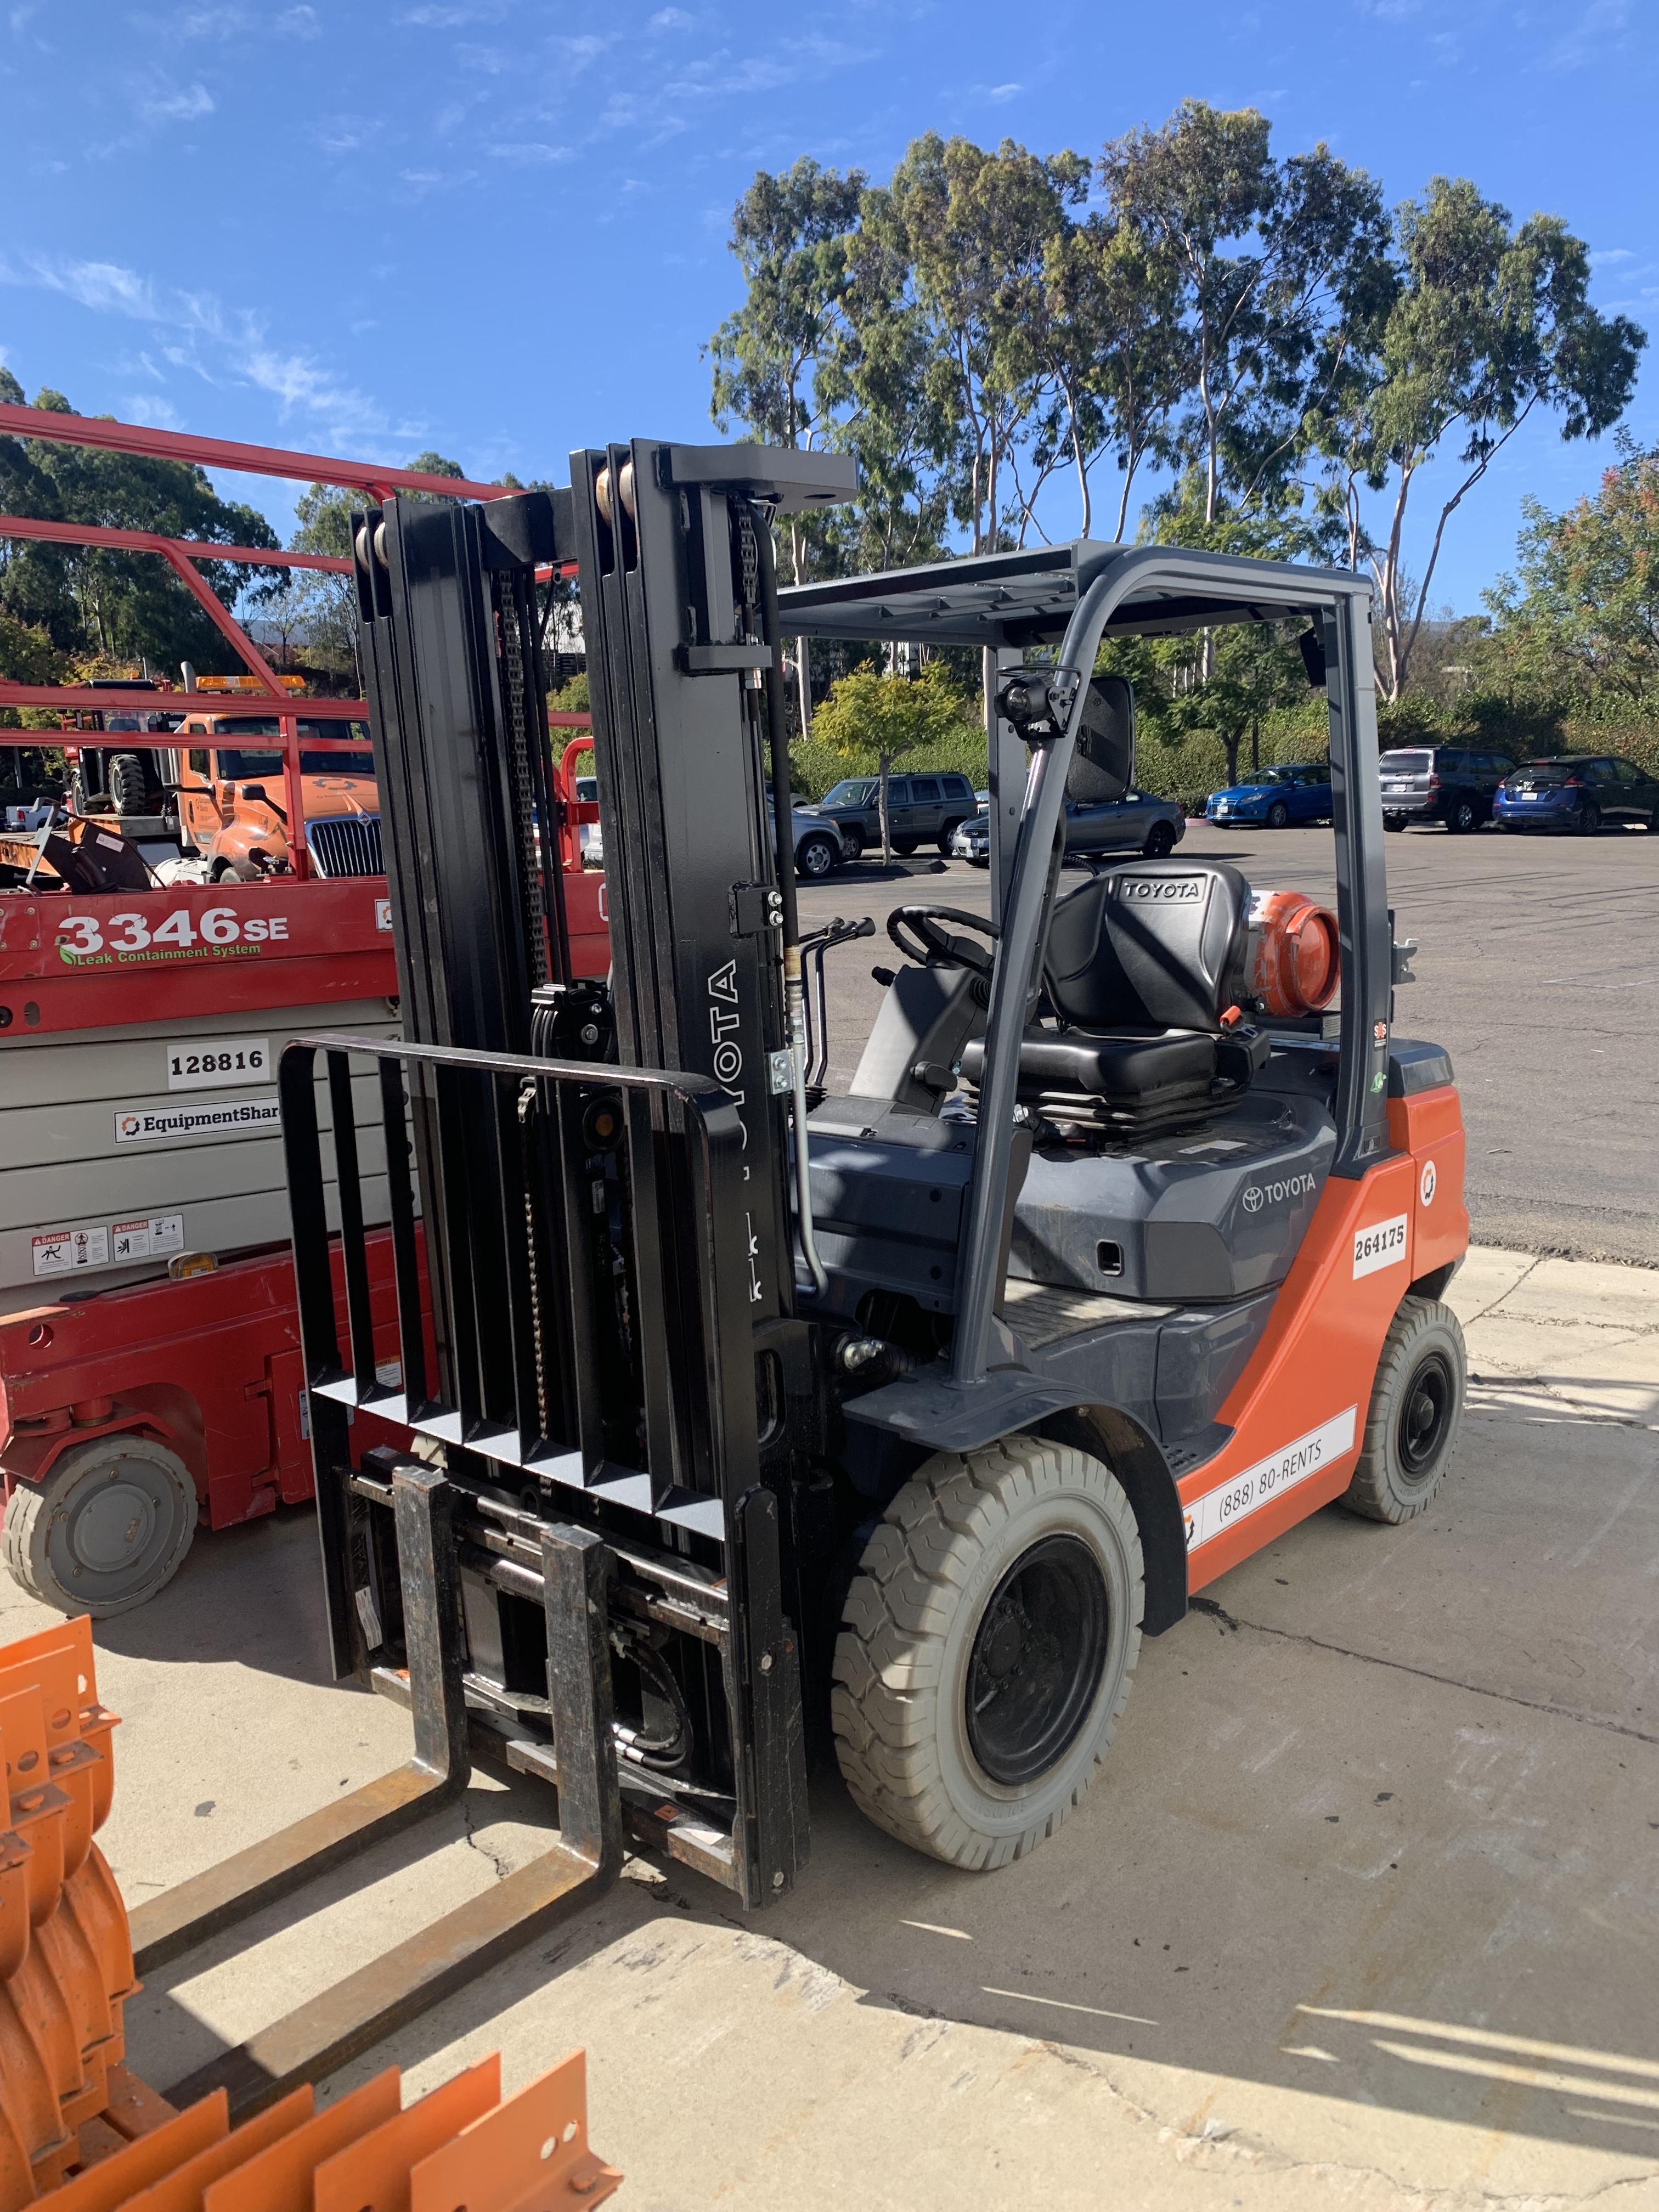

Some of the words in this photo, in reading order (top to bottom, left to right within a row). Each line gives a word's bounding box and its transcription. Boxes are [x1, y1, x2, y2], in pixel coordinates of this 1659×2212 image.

[1125, 882, 1198, 898] TOYOTA
[76, 954, 113, 966] Leak
[117, 947, 208, 963] Containment
[212, 944, 261, 957] System
[171, 1051, 263, 1076] 128816
[708, 959, 749, 1181] OTA
[143, 1106, 280, 1132] EquipmentShar
[1265, 1172, 1316, 1204] TOYOTA
[42, 1234, 70, 1244] DANGER
[121, 1222, 148, 1231] DANGER
[1355, 1224, 1404, 1261] 264175
[1219, 1481, 1254, 1522] (888)
[1259, 1439, 1322, 1494] 80-RENTS
